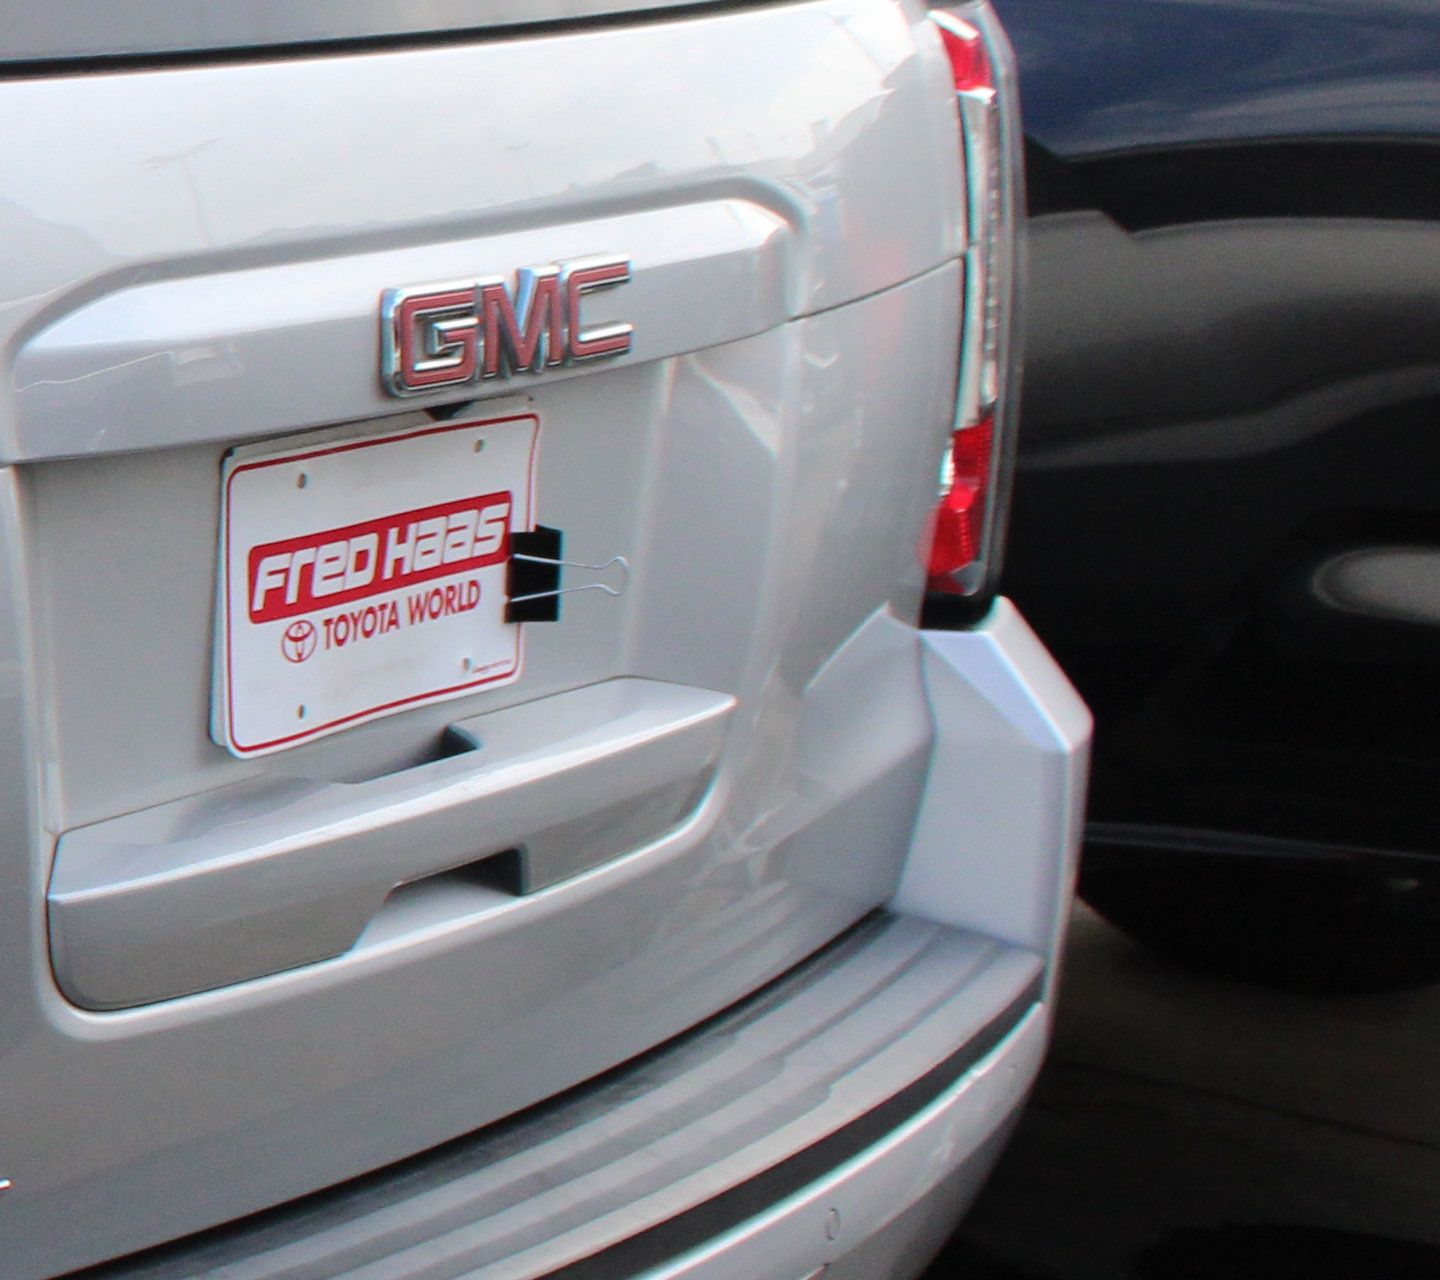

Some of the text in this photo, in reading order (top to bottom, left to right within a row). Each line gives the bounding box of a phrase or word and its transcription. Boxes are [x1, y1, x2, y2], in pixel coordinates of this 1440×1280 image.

[380, 252, 633, 400] GMC
[323, 579, 481, 650] TOYOTA WORLD
